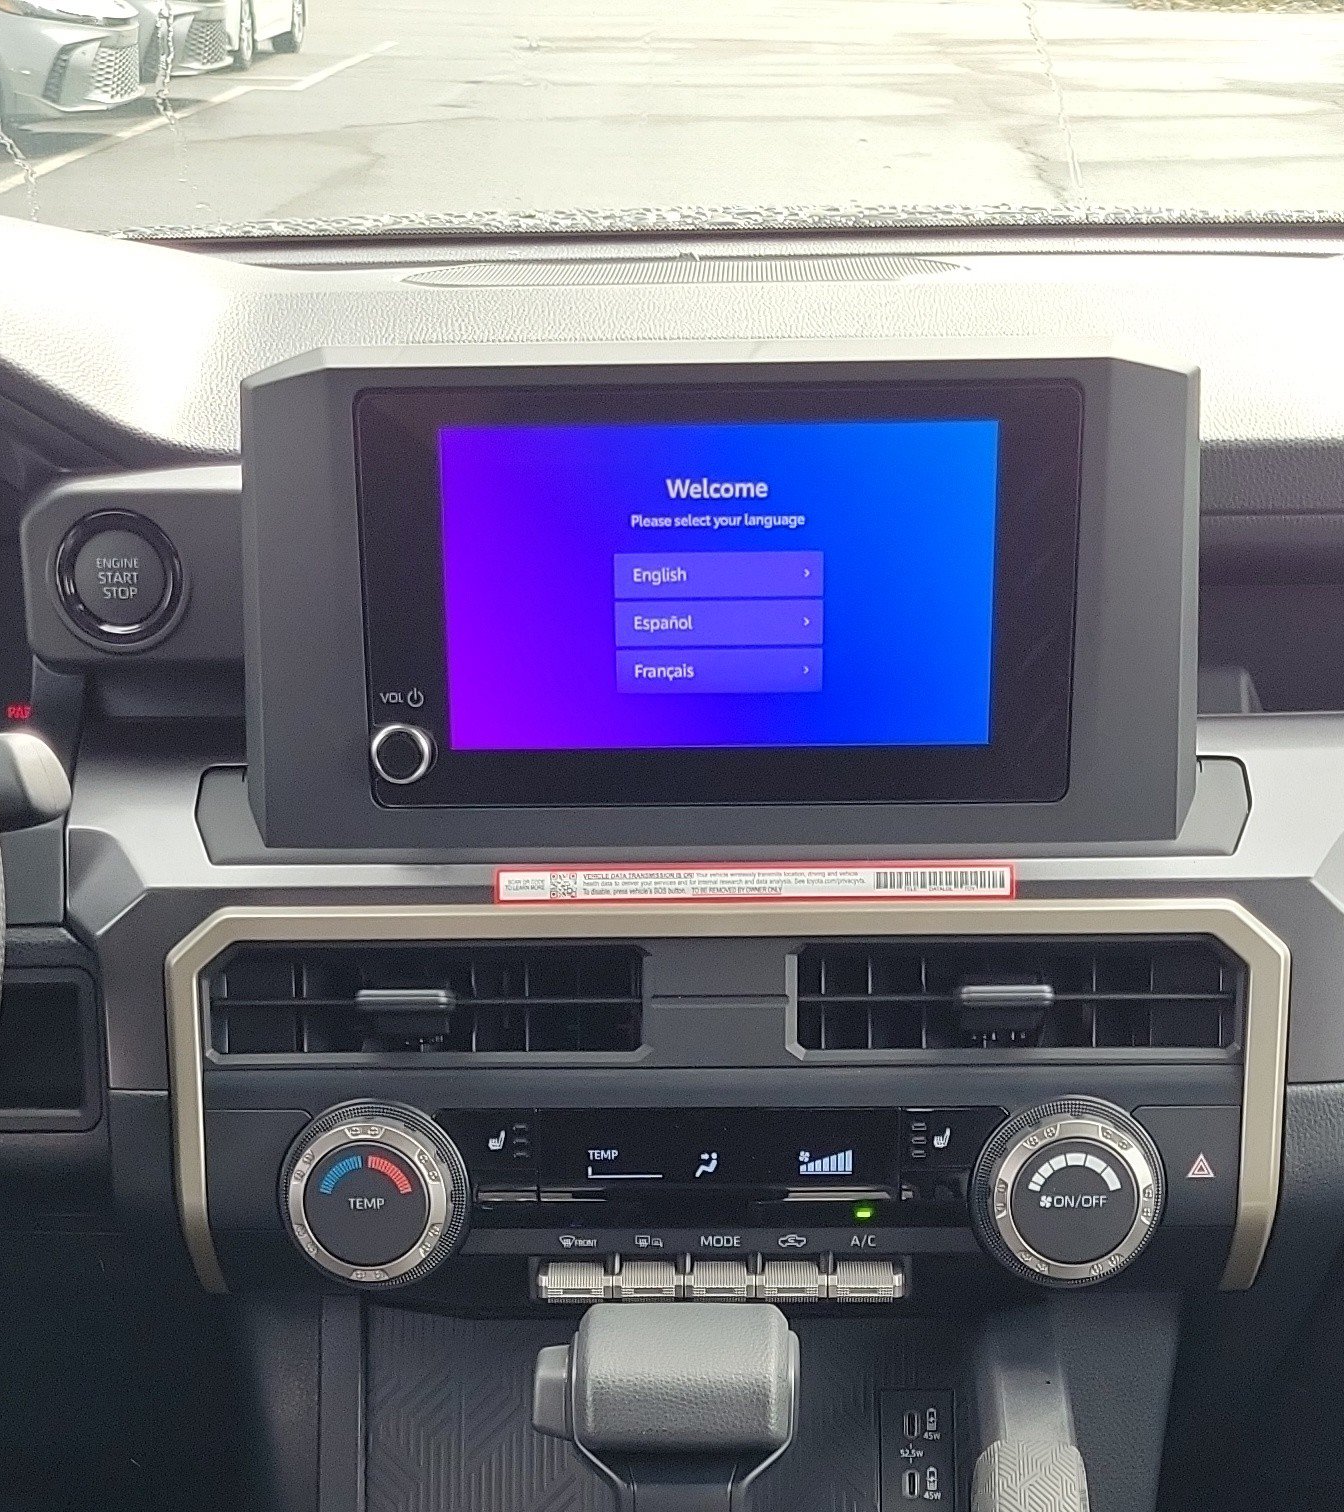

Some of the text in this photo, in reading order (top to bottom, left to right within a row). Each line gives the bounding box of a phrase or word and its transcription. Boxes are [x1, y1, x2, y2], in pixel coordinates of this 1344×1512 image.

[666, 478, 769, 499] Welcome
[631, 513, 805, 529] Please select your language
[96, 558, 139, 569] ENGINE
[98, 572, 139, 585] START
[633, 567, 687, 585] English
[103, 587, 138, 599] STOP
[634, 615, 693, 633] Español
[634, 664, 694, 681] Français
[379, 692, 404, 704] VOL
[588, 1149, 619, 1161] TEMP
[348, 1197, 385, 1210] TEMP
[1053, 1193, 1107, 1209] ON/OFF
[700, 1235, 741, 1248] MODE
[850, 1235, 876, 1248] A/C
[923, 1431, 941, 1440] 45W
[923, 1491, 942, 1500] 45W
